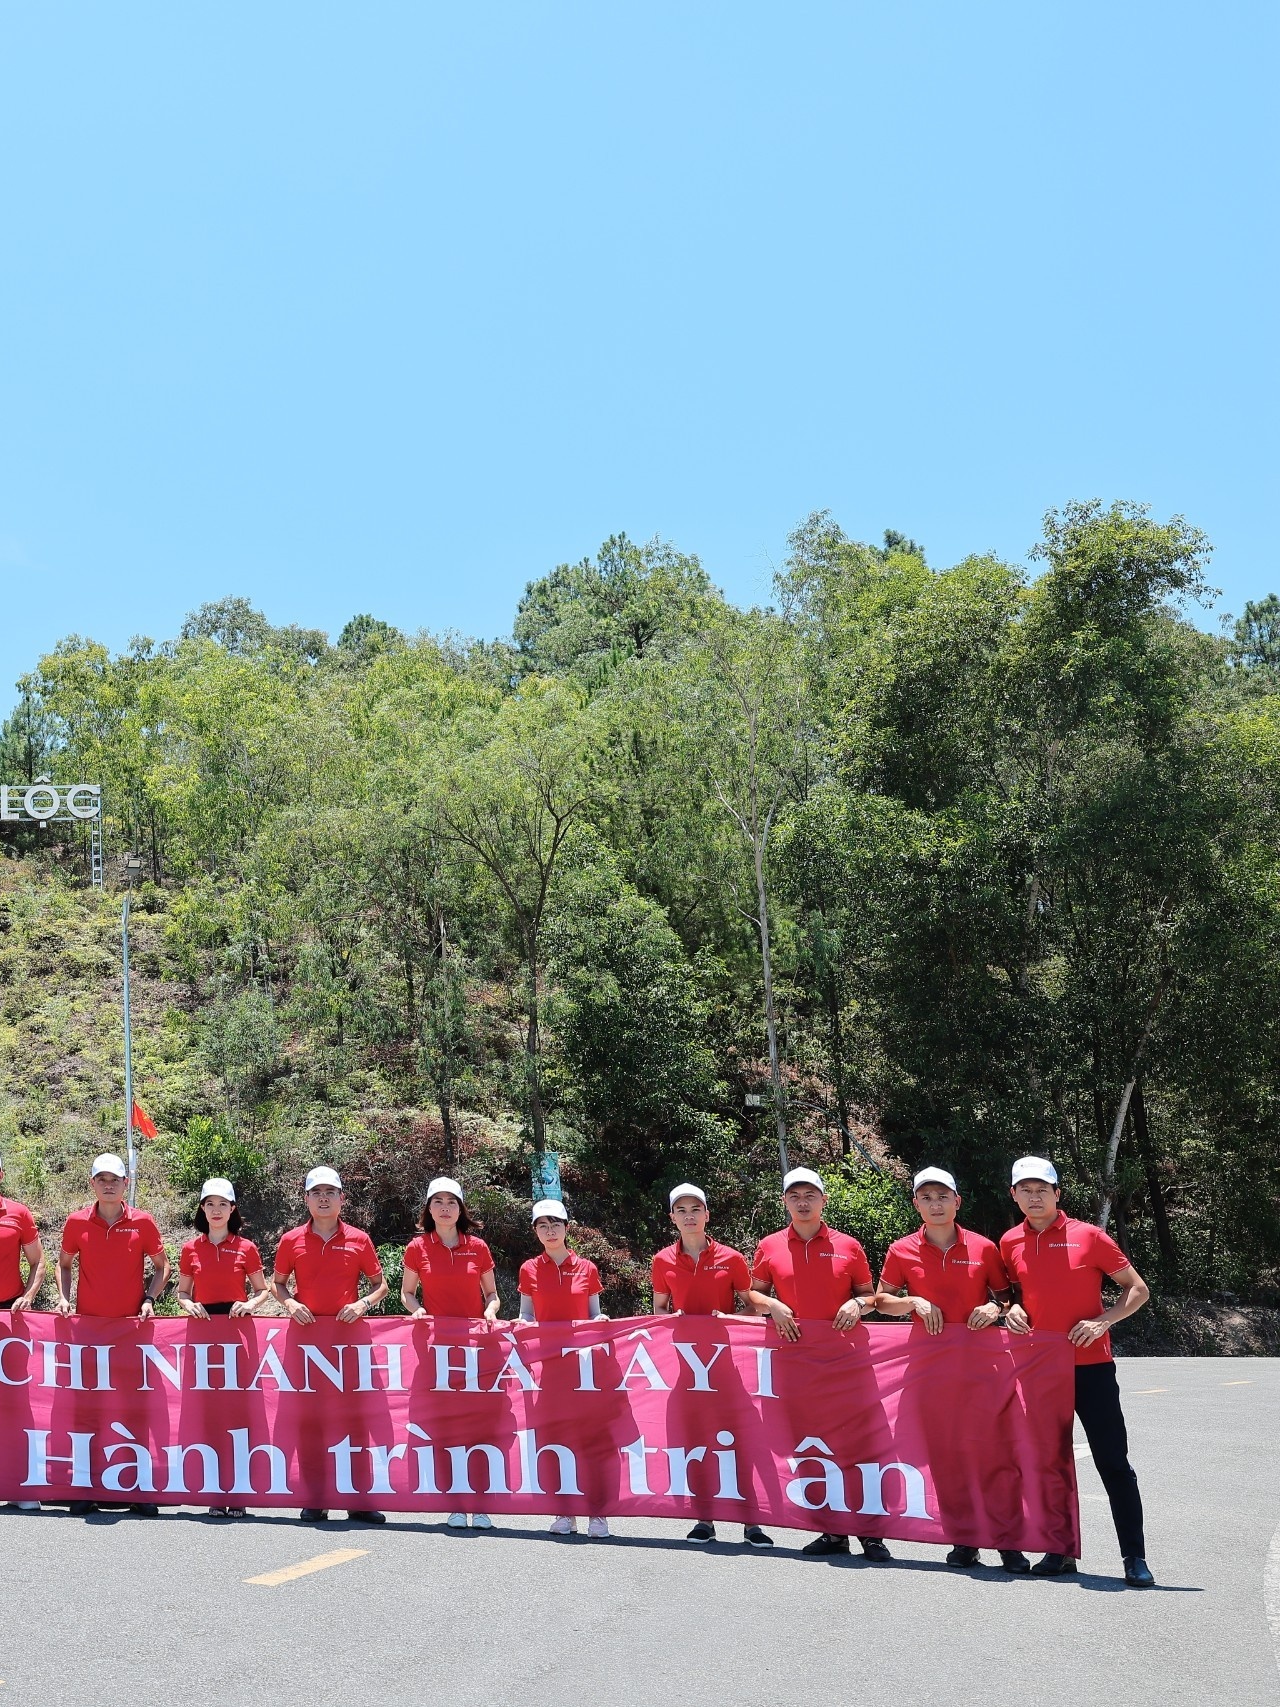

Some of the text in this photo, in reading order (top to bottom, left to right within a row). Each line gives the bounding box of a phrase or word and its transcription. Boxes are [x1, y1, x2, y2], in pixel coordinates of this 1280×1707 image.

[0, 775, 101, 828] LỘC
[136, 1328, 409, 1393] NHÁNH
[429, 1333, 542, 1392] HÀ
[561, 1329, 728, 1392] TÂY
[749, 1346, 780, 1399] I
[20, 1421, 294, 1494] Hành
[328, 1422, 584, 1496] trình
[620, 1430, 745, 1500] tri
[786, 1437, 934, 1521] ân
